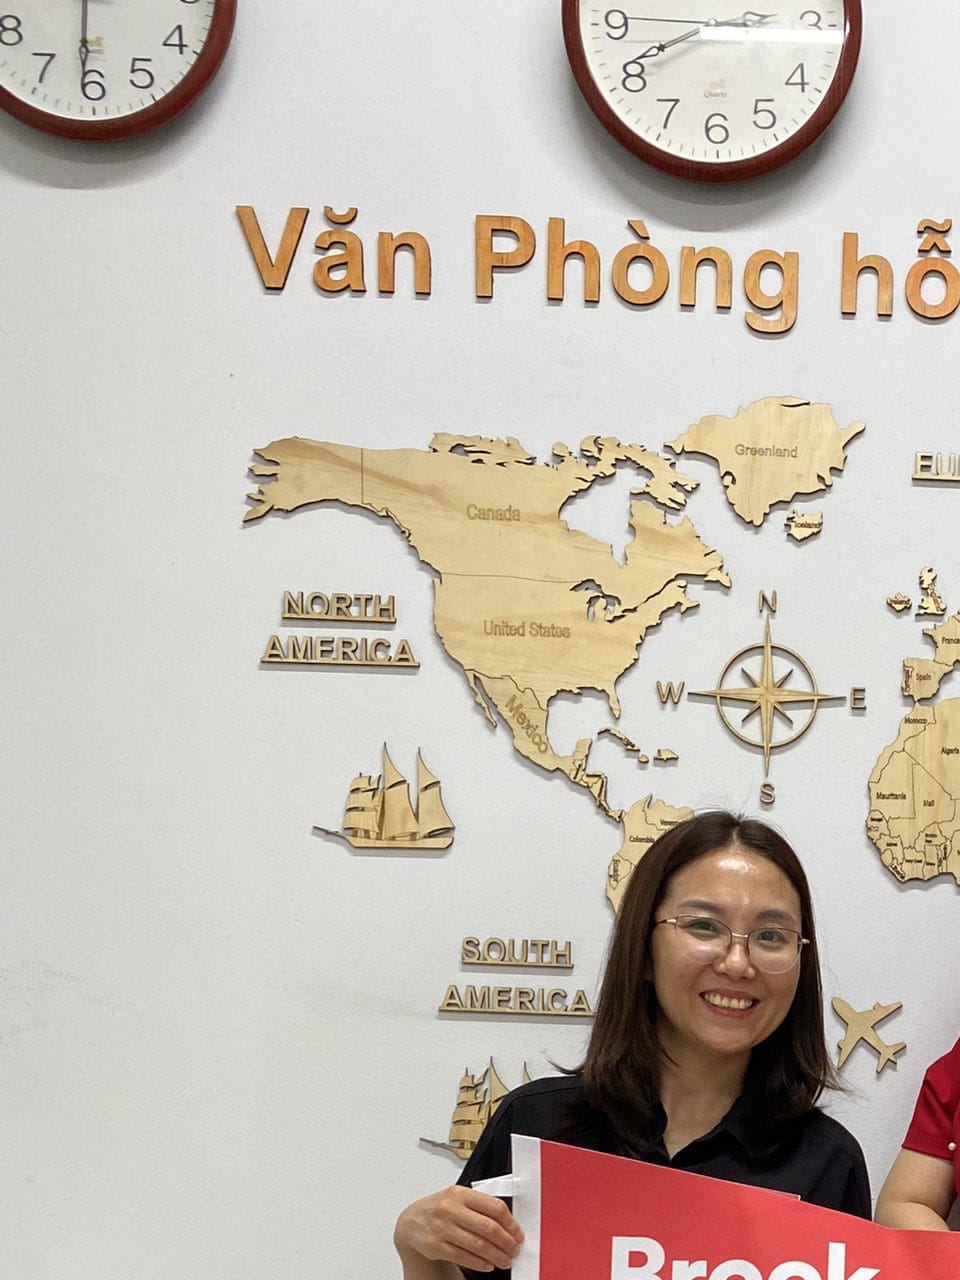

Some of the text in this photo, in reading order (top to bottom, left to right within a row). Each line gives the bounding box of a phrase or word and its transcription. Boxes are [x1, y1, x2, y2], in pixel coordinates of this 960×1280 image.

[0, 15, 23, 45] 8
[604, 9, 629, 39] 9
[162, 25, 187, 54] 4
[32, 53, 55, 83] 7
[129, 58, 154, 88] 5
[621, 61, 646, 92] 8
[784, 63, 809, 92] 4
[81, 70, 106, 100] 6
[656, 99, 680, 129] 7
[704, 113, 729, 144] 6
[752, 99, 777, 129] 5
[236, 204, 431, 295] Văn
[475, 214, 800, 334] Phòng
[735, 443, 798, 459] Greenland
[466, 503, 521, 522] Canada
[282, 591, 396, 620] NORTH
[759, 590, 777, 614] N
[483, 620, 571, 639] United States
[261, 634, 418, 665] AMERICA
[656, 680, 685, 705] W
[850, 686, 868, 711] E
[505, 694, 548, 755] Mexico
[759, 782, 777, 805] S
[462, 936, 573, 967] SOUTH
[440, 984, 595, 1016] AMERICA
